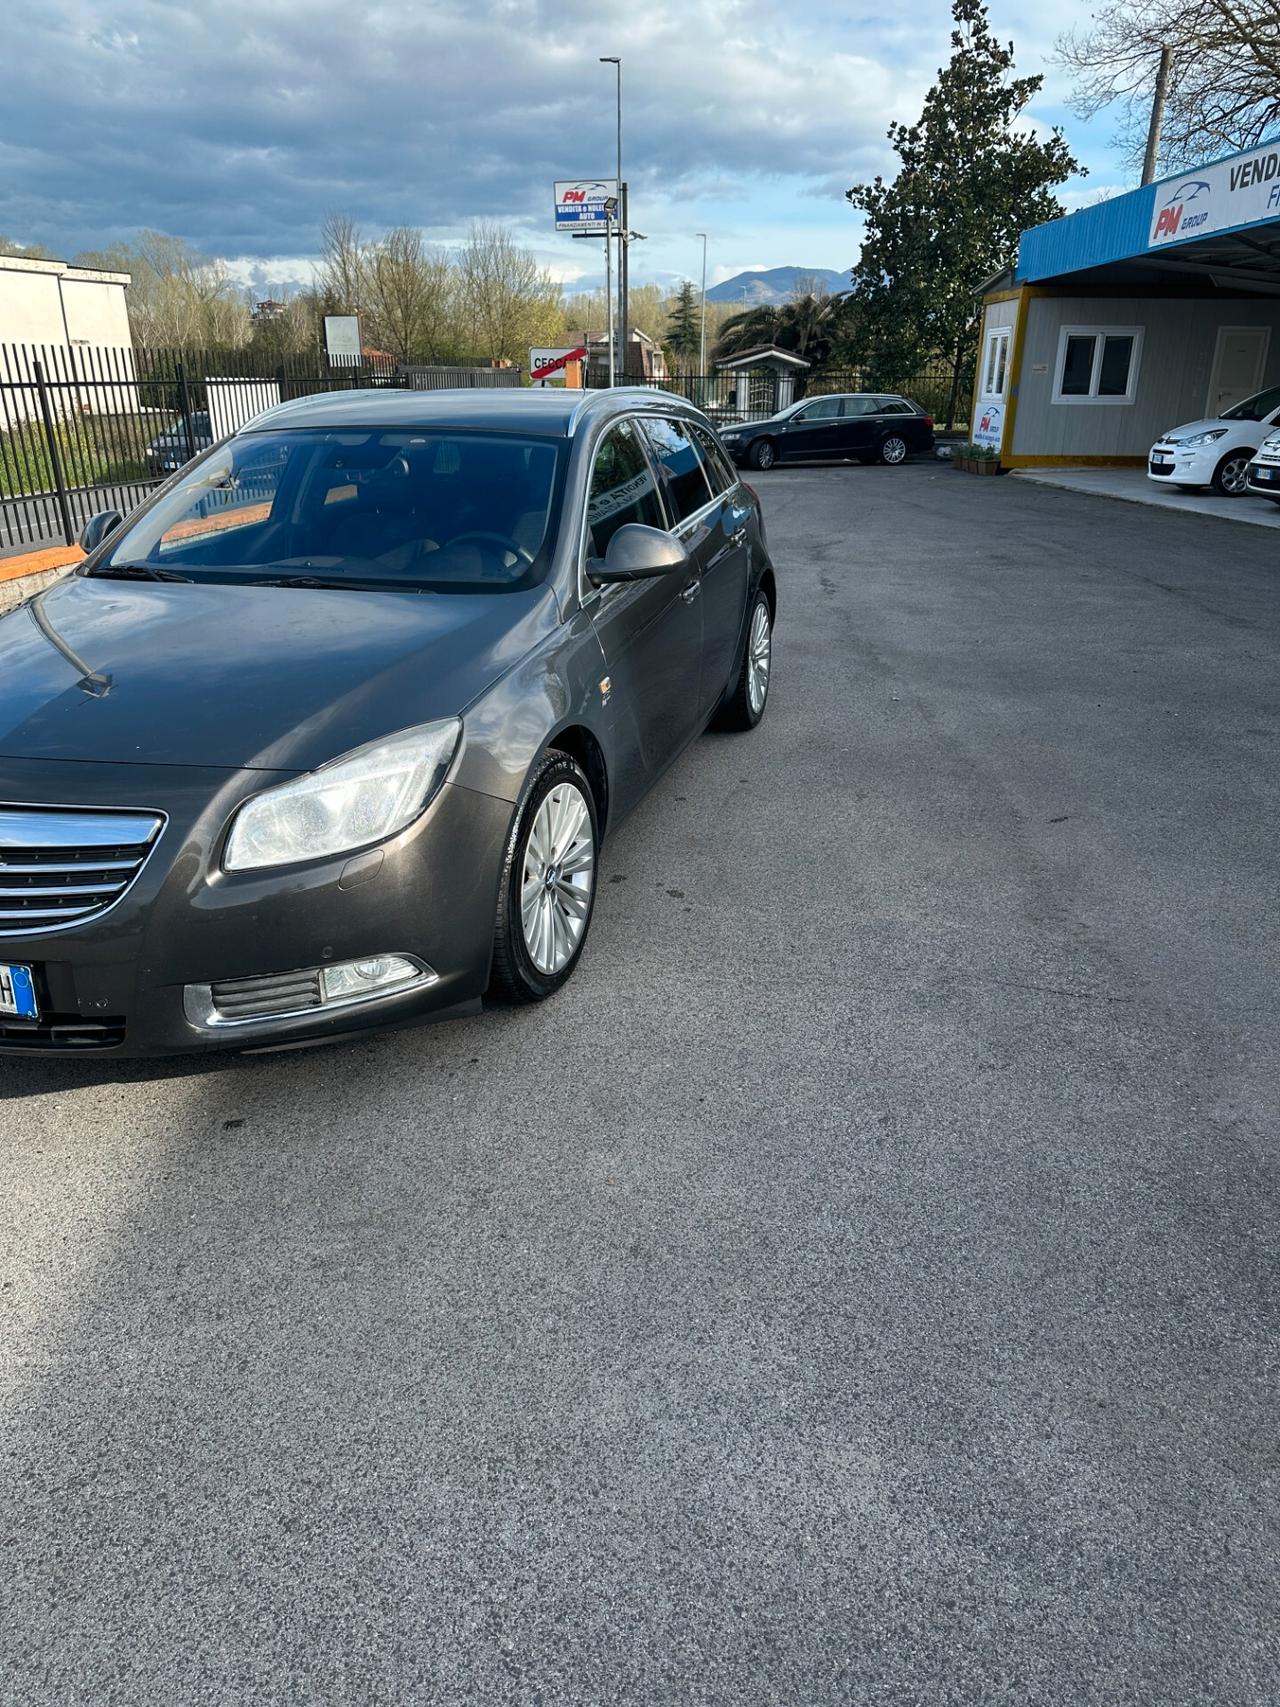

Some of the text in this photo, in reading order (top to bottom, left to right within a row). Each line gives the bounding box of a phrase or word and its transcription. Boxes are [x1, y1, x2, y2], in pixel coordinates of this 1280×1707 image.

[563, 190, 586, 203] PM
[558, 205, 582, 213] VENDITA
[579, 212, 595, 220] AUTO
[1153, 203, 1208, 240] PM GROUP
